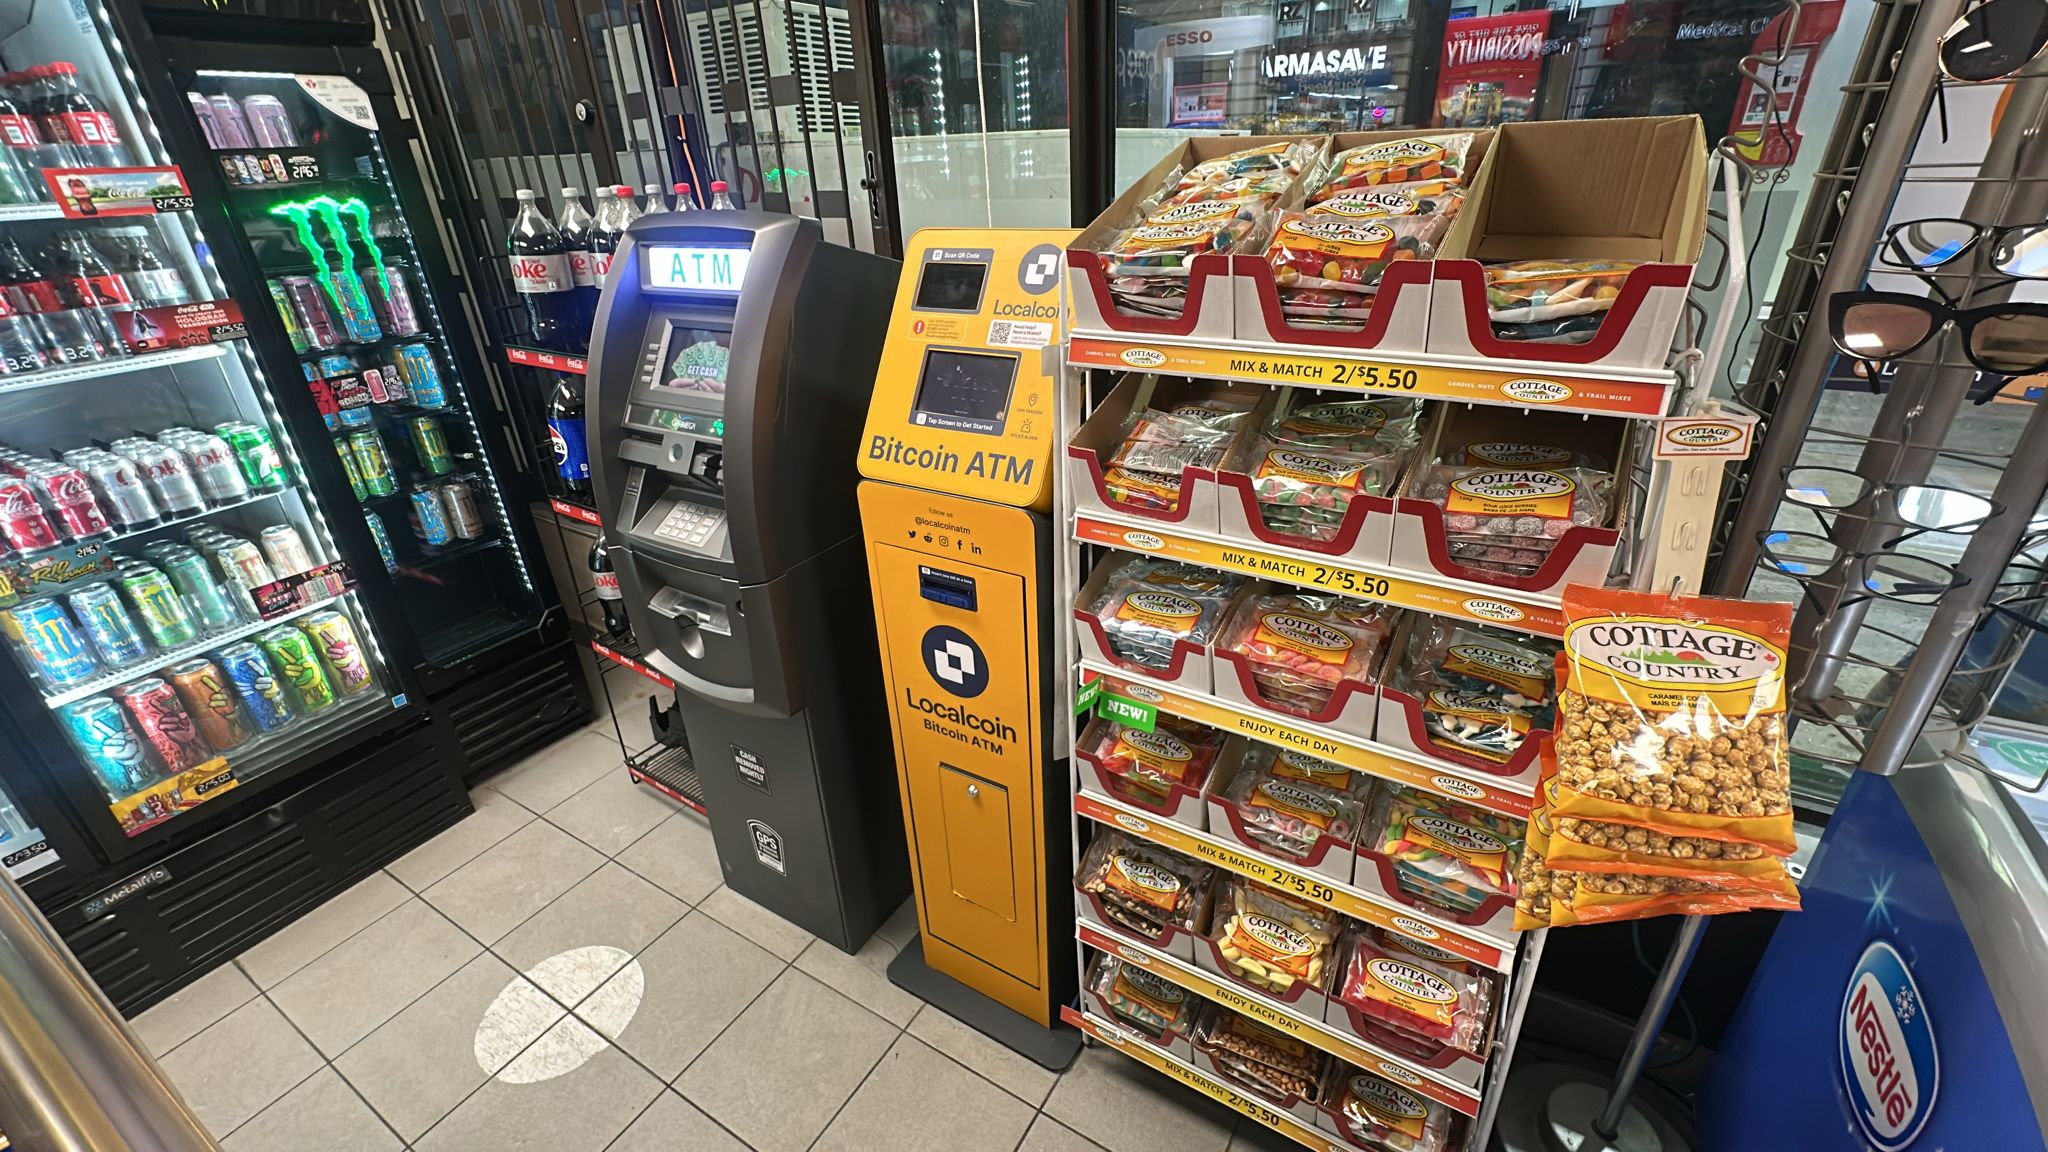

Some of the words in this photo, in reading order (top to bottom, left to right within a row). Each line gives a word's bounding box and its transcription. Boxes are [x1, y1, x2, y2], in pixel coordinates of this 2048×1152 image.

[1166, 30, 1213, 47] ESSO
[1261, 45, 1388, 78] ARMASAVE
[1361, 142, 1432, 160] COTTAGE
[1338, 193, 1407, 208] OTTAGE
[1300, 228, 1368, 241] COUNTRY
[958, 252, 965, 260] QR
[671, 252, 732, 285] ATM
[1126, 349, 1162, 361] COTTAGE
[687, 364, 700, 375] GET
[700, 366, 719, 378] CASH
[1231, 359, 1256, 373] MIX
[1258, 362, 1269, 374] &
[1273, 362, 1323, 379] MATCH
[1331, 364, 1418, 390] 2/$5.50
[1447, 381, 1475, 390] CANDIES,
[1478, 383, 1495, 391] NUTS
[1510, 381, 1564, 395] COTTAGE
[1513, 391, 1556, 400] COUNTRY
[1608, 394, 1632, 402] MIXES
[928, 417, 938, 425] Tap
[938, 418, 956, 428] Screen
[962, 421, 973, 429] Get
[973, 423, 993, 431] Started
[1679, 426, 1730, 437] COTTAGE
[1683, 435, 1724, 443] COUNTRY
[1482, 443, 1558, 455] COTTAGE
[869, 435, 959, 473] Bitcoin
[965, 451, 1034, 486] ATM
[1282, 453, 1355, 472] COTTAGE
[1468, 472, 1559, 487] COTTAGE
[1474, 486, 1548, 497] COUNTRY
[928, 507, 945, 516] follow
[915, 516, 971, 535] @localcoinatm
[1128, 533, 1161, 545] COTTAGE
[1222, 551, 1246, 565] MIX
[1248, 557, 1257, 568] &
[1260, 559, 1306, 577] MATCH
[1312, 567, 1389, 597] 2/$5.50
[1138, 593, 1193, 611] COTTAGE
[1139, 602, 1184, 614] COUNTRY
[1470, 600, 1516, 615] COTTAGE
[1474, 608, 1510, 620] COUNTRY
[1275, 617, 1344, 643] COTTAGE
[1278, 626, 1332, 648] COUNTRY
[1590, 625, 1757, 661] COTTAGE
[1607, 655, 1742, 680] COUNTRY
[1078, 683, 1099, 705] NEW!
[1648, 693, 1684, 701] CARAMEL
[906, 687, 1017, 743] Localcoin
[1107, 699, 1148, 723] NEW!
[924, 718, 968, 744] Bitcoin
[971, 735, 1003, 756] ATM
[1131, 730, 1185, 754] COTTAGE
[1239, 718, 1276, 738] ENJOY
[1279, 730, 1310, 747] EACH
[1313, 740, 1339, 755] DAY
[739, 750, 758, 763] CASH
[1132, 738, 1176, 757] COUNTRY
[735, 756, 766, 775] REMOVED
[739, 765, 764, 782] NIGHTLY
[198, 773, 232, 793] 2/$5.00
[1438, 776, 1482, 794] COTTAGE
[1496, 796, 1513, 806] TRAIL
[1514, 801, 1532, 811] MIXES
[756, 831, 778, 850] GPS
[1421, 818, 1494, 846] COTTAGE
[1427, 825, 1485, 850] COUNTRY
[6, 842, 48, 865] 2/$3.50
[1124, 859, 1173, 885] COTTAGE
[1125, 868, 1165, 889] COUNTRY
[1197, 843, 1216, 858] MIX
[1218, 851, 1227, 862] &
[1228, 855, 1267, 876] MATCH
[1271, 869, 1334, 903] 2/$5.50
[104, 870, 165, 905] Metalfrio
[1249, 916, 1306, 948] COTTAGE
[1397, 917, 1434, 936] COTTAGE
[1251, 928, 1299, 953] COUNTRY
[1399, 938, 1451, 960] COUNTRY
[1131, 966, 1176, 996] COTTAGE
[1379, 962, 1449, 994] COTTAGE
[1383, 975, 1438, 999] COUNTRY
[1215, 988, 1247, 1008] ENJOY
[1250, 1004, 1275, 1021] EACH
[1278, 1017, 1300, 1032] DAY
[1850, 984, 1913, 1128] Nestlé
[1165, 1061, 1182, 1076] MIX
[1183, 1070, 1191, 1080] &
[1191, 1074, 1224, 1096] MATCH
[1228, 1092, 1280, 1127] 2/$5.50
[1357, 1078, 1418, 1111] COTTAGE
